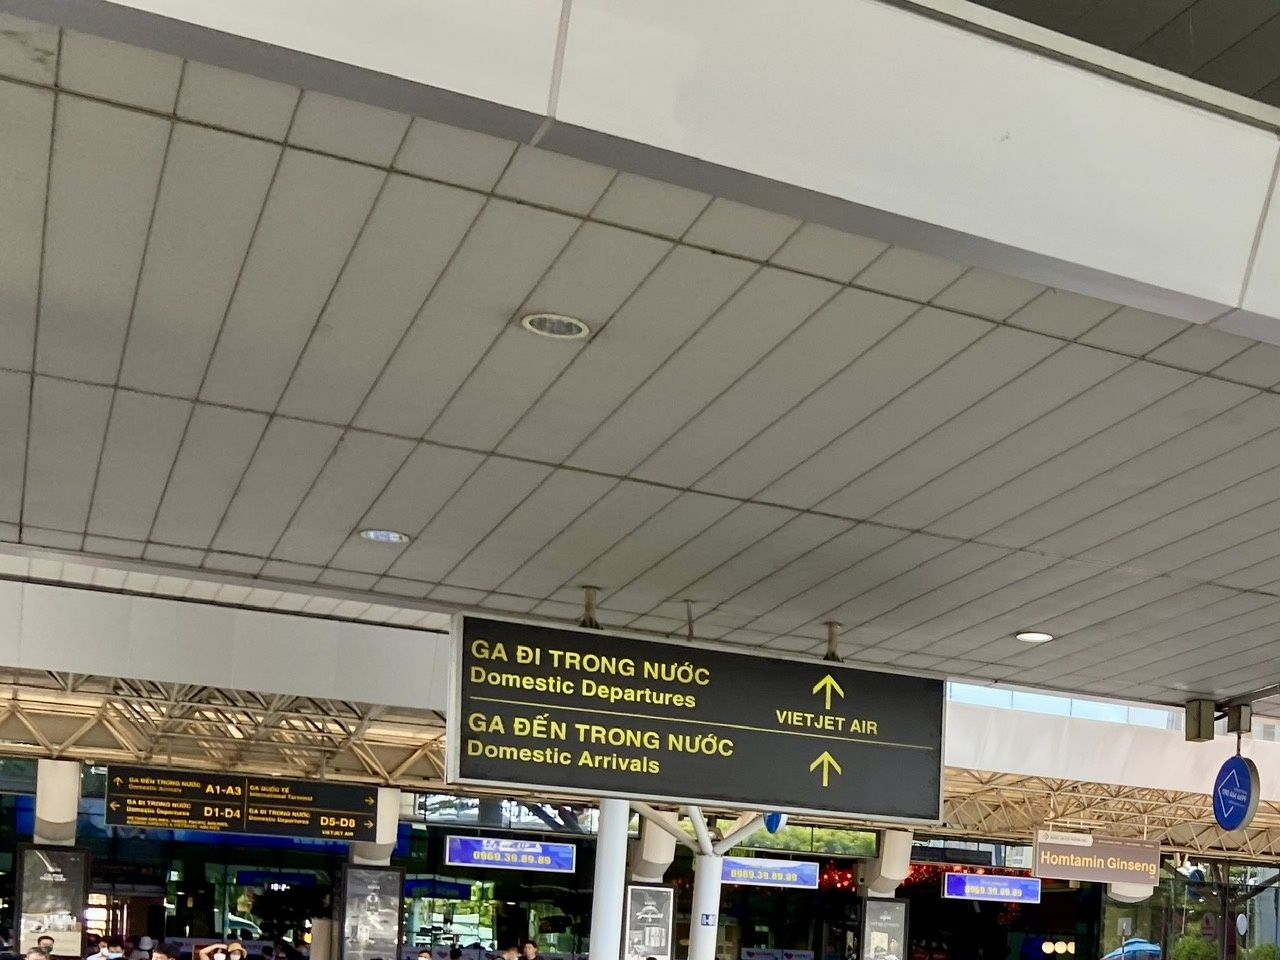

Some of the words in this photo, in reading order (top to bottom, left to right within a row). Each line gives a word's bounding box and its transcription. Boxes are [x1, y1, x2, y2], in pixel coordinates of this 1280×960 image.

[471, 639, 508, 662] GA
[516, 645, 540, 665] ĐI
[549, 650, 635, 677] TRONG
[643, 661, 710, 686] NƯỚC
[470, 666, 574, 694] Domestic
[582, 679, 696, 708] Departures
[468, 712, 505, 734] GA
[513, 713, 567, 740] ĐẾN
[574, 723, 660, 749] TRONG
[668, 733, 734, 757] NƯỚC
[776, 709, 845, 731] VIETJET
[850, 719, 878, 735] AIR
[467, 739, 572, 765] Domestic
[578, 750, 660, 774] Arrivals
[206, 784, 242, 796] A1-A3
[204, 806, 241, 818] D1-D4
[320, 816, 356, 828] D5-D8
[1040, 850, 1104, 868] Homtamin
[1107, 857, 1156, 874] Ginseng
